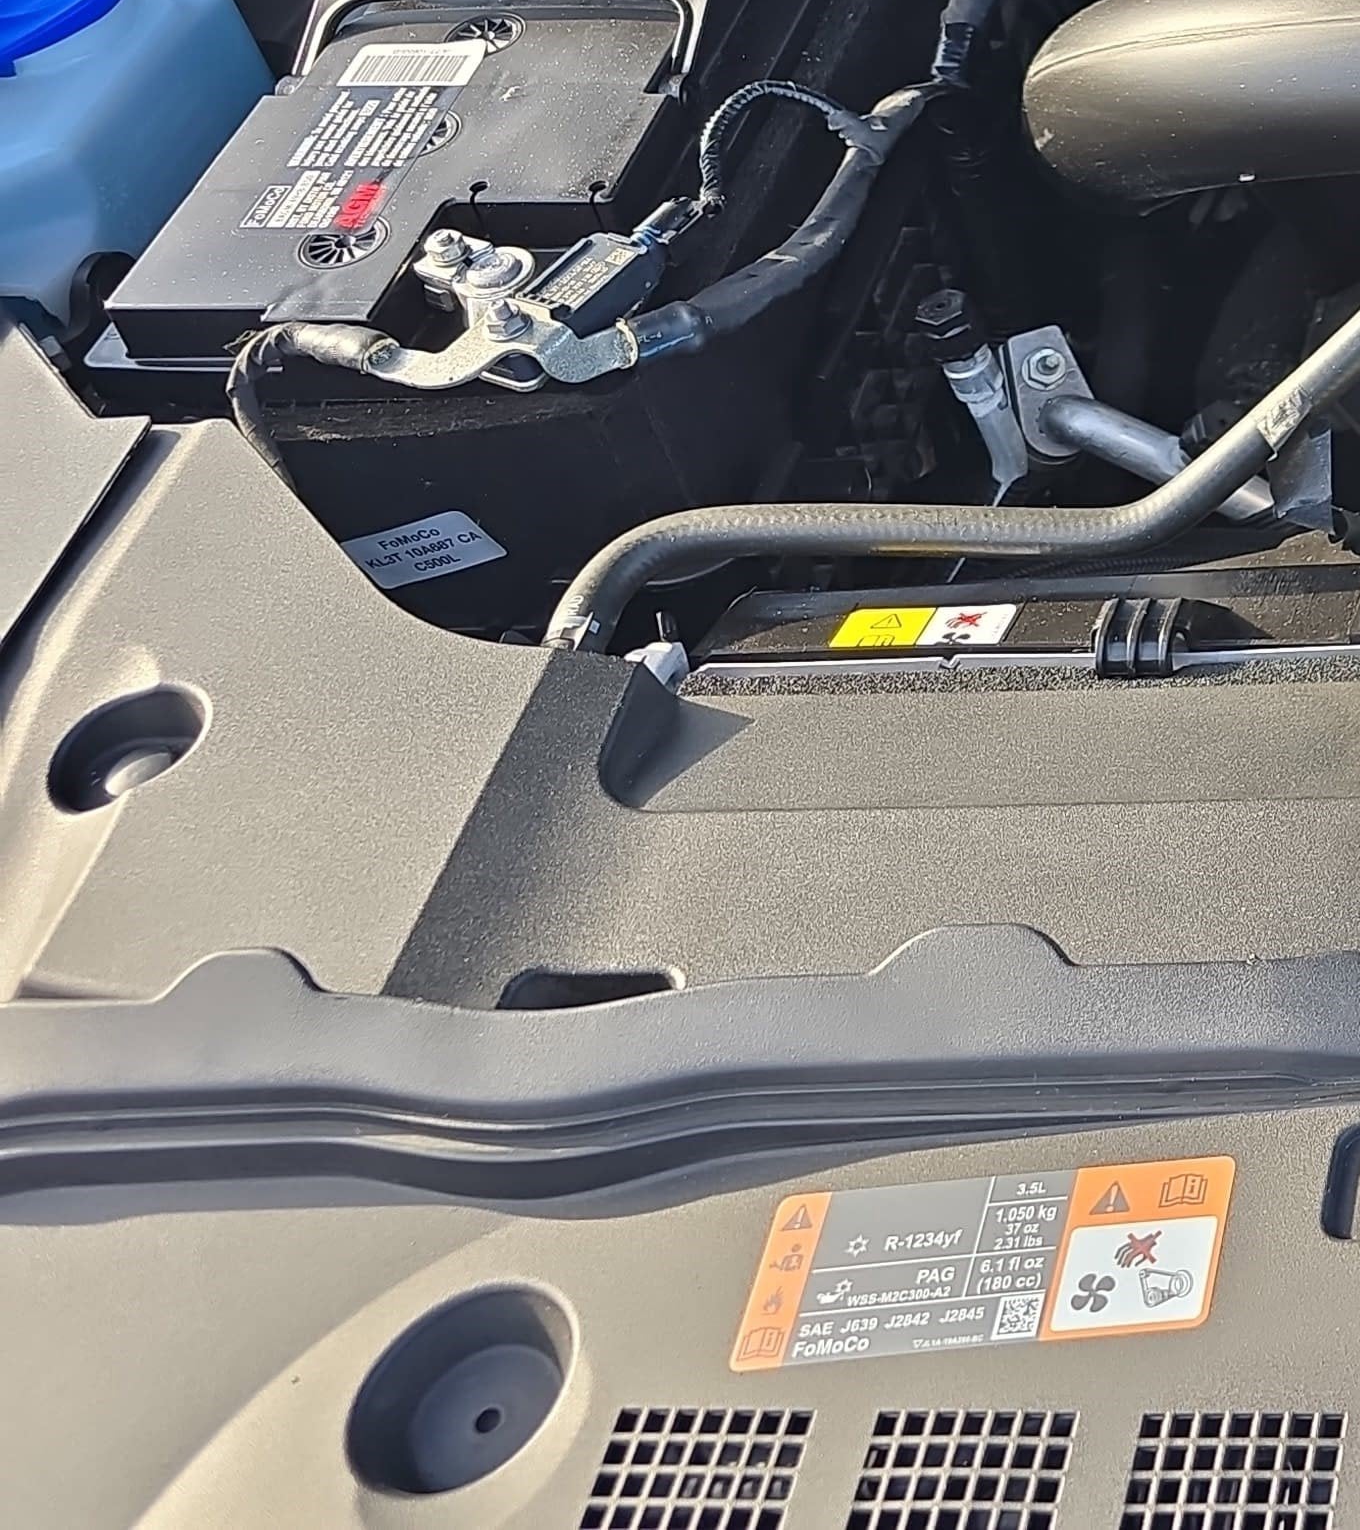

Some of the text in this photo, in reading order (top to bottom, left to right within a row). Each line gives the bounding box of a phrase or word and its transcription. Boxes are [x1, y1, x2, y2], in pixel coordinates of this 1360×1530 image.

[247, 188, 285, 223] FoMoCo
[337, 185, 377, 226] AGM
[377, 528, 440, 551] FoMoCo
[365, 553, 404, 570] KL3T
[457, 531, 483, 544] CA
[414, 554, 461, 572] C500L
[1016, 1182, 1047, 1196] 3.5L
[995, 1204, 1058, 1222] 1.050 kg
[1004, 1223, 1040, 1235] 37 oz
[884, 1229, 963, 1252] R-1234yf
[993, 1236, 1043, 1251] 2.31 lbs
[980, 1257, 1045, 1273] 6.1 fl oz
[916, 1267, 956, 1285] PAG
[977, 1273, 1042, 1294] (180 cc)
[846, 1286, 952, 1306] WSS-M2C300-A2
[798, 1307, 985, 1338] SAE J639 J2842 J2845
[791, 1337, 870, 1358] FoMoCo
